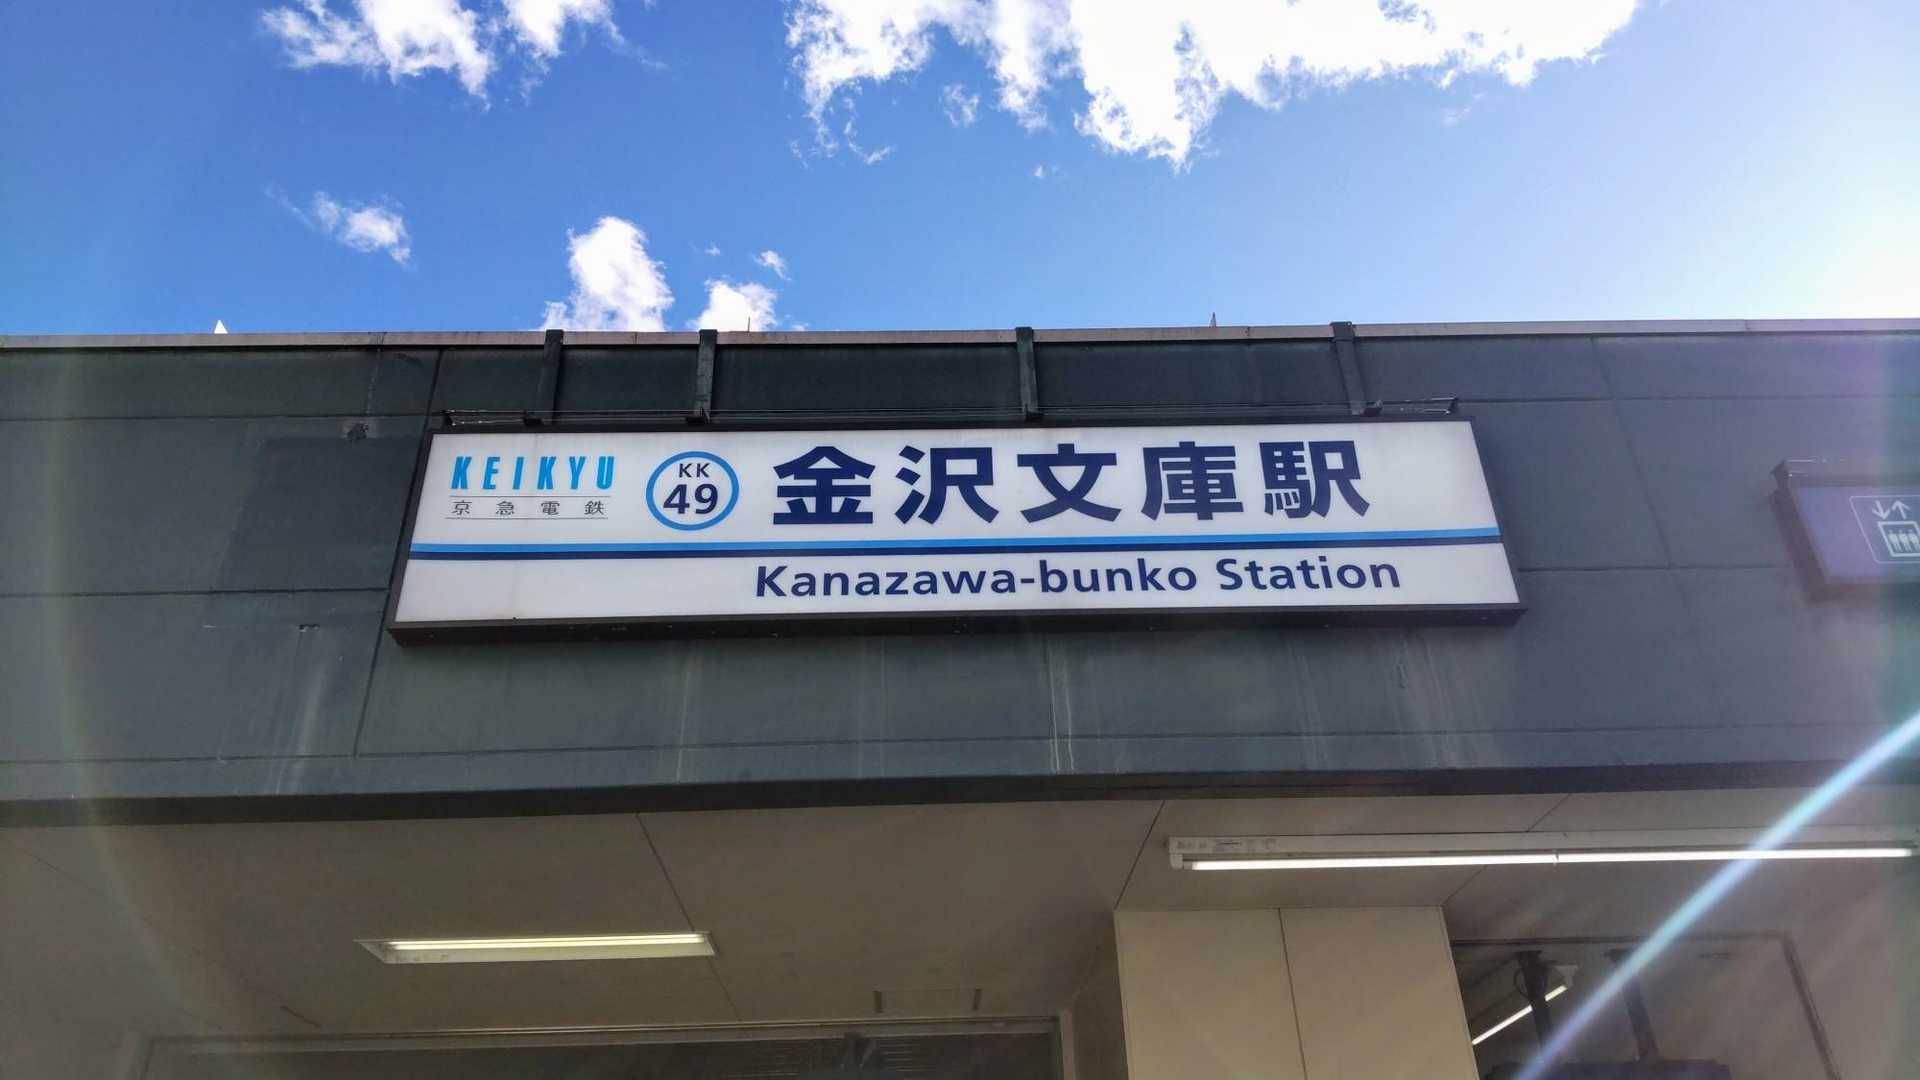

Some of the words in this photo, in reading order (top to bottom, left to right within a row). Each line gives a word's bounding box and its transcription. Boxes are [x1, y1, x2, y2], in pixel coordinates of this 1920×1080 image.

[451, 456, 615, 490] KEIKYU
[679, 463, 710, 478] KK
[772, 441, 1370, 525] 金沢文庫駅
[452, 500, 605, 516] 京急電鉄
[663, 484, 719, 514] 49
[756, 558, 1197, 597] Kanazawa-bunko
[1216, 556, 1401, 592] Station
